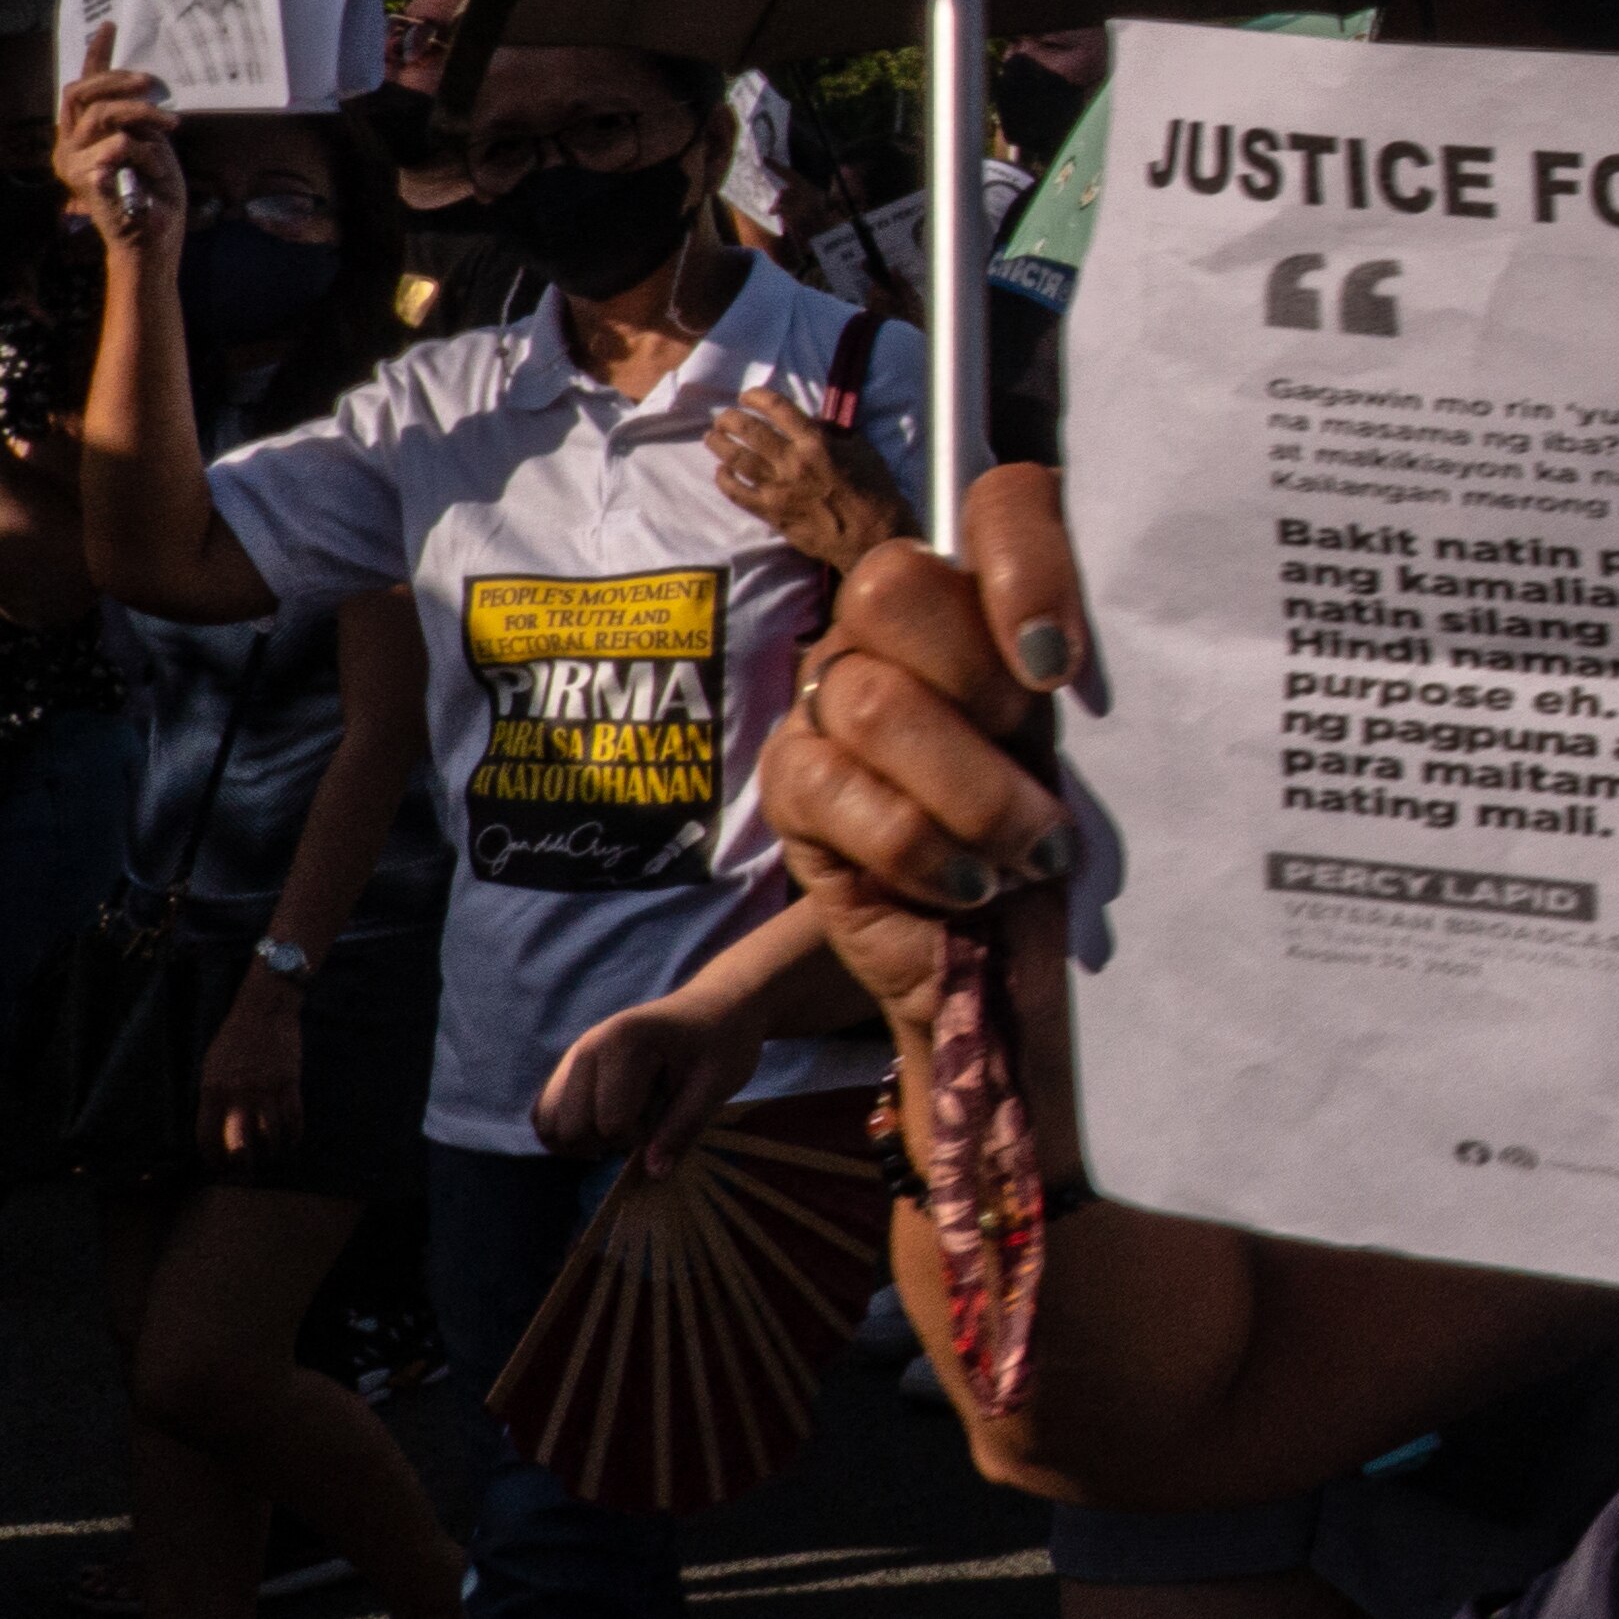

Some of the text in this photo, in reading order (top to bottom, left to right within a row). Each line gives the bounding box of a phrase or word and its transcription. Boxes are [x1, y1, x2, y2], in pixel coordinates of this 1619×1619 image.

[1147, 118, 1497, 219] JUSTICE
[1276, 517, 1419, 559] Bakit
[1433, 537, 1581, 570] natin
[578, 581, 712, 606] MOVEMENT
[1280, 560, 1381, 596] ang
[504, 608, 671, 631] FOR TRUTH AND
[593, 629, 708, 650] REFORMS
[1283, 595, 1423, 631] natin
[1438, 606, 1611, 647] silang
[1287, 626, 1434, 666] Hindi
[482, 660, 713, 720] PIRMA
[1283, 670, 1515, 711] purpose
[1533, 685, 1619, 720] eh.
[489, 721, 713, 762] PARA SA BAYAN
[1282, 709, 1350, 742] ng
[1361, 715, 1600, 758] pagpuna
[471, 762, 713, 805] AT KATOTOHANAN
[1282, 747, 1405, 780] para
[1282, 784, 1616, 839] nating mali.
[1282, 861, 1580, 913] PERCY LAPID
